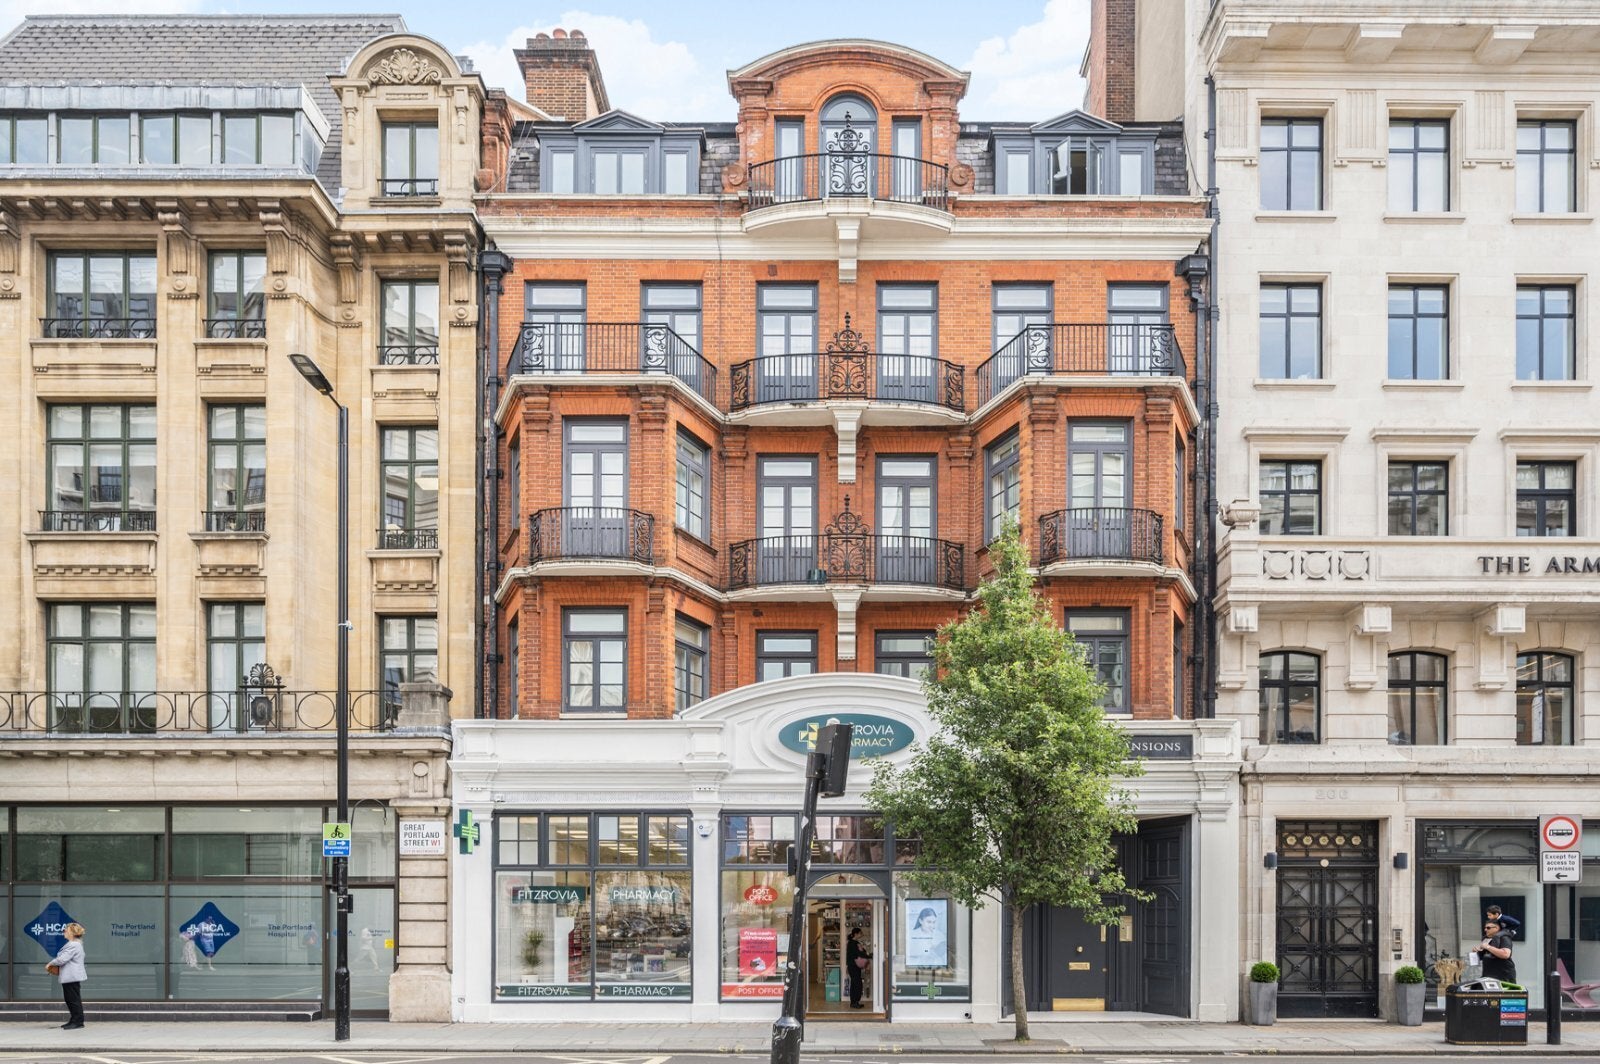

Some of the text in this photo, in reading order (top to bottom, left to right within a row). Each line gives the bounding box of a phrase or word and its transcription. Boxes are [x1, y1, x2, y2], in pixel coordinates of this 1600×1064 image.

[1477, 556, 1531, 574] THE
[851, 724, 894, 735] ROVIA
[850, 737, 894, 747] RMACY
[1126, 742, 1181, 751] NSIONS
[403, 823, 426, 831] GREAT
[518, 890, 675, 900] FITZROVIA PHARMACY
[46, 923, 67, 932] HCA
[202, 924, 224, 932] HCA
[518, 986, 675, 996] FITZROVIA PHARMACY
